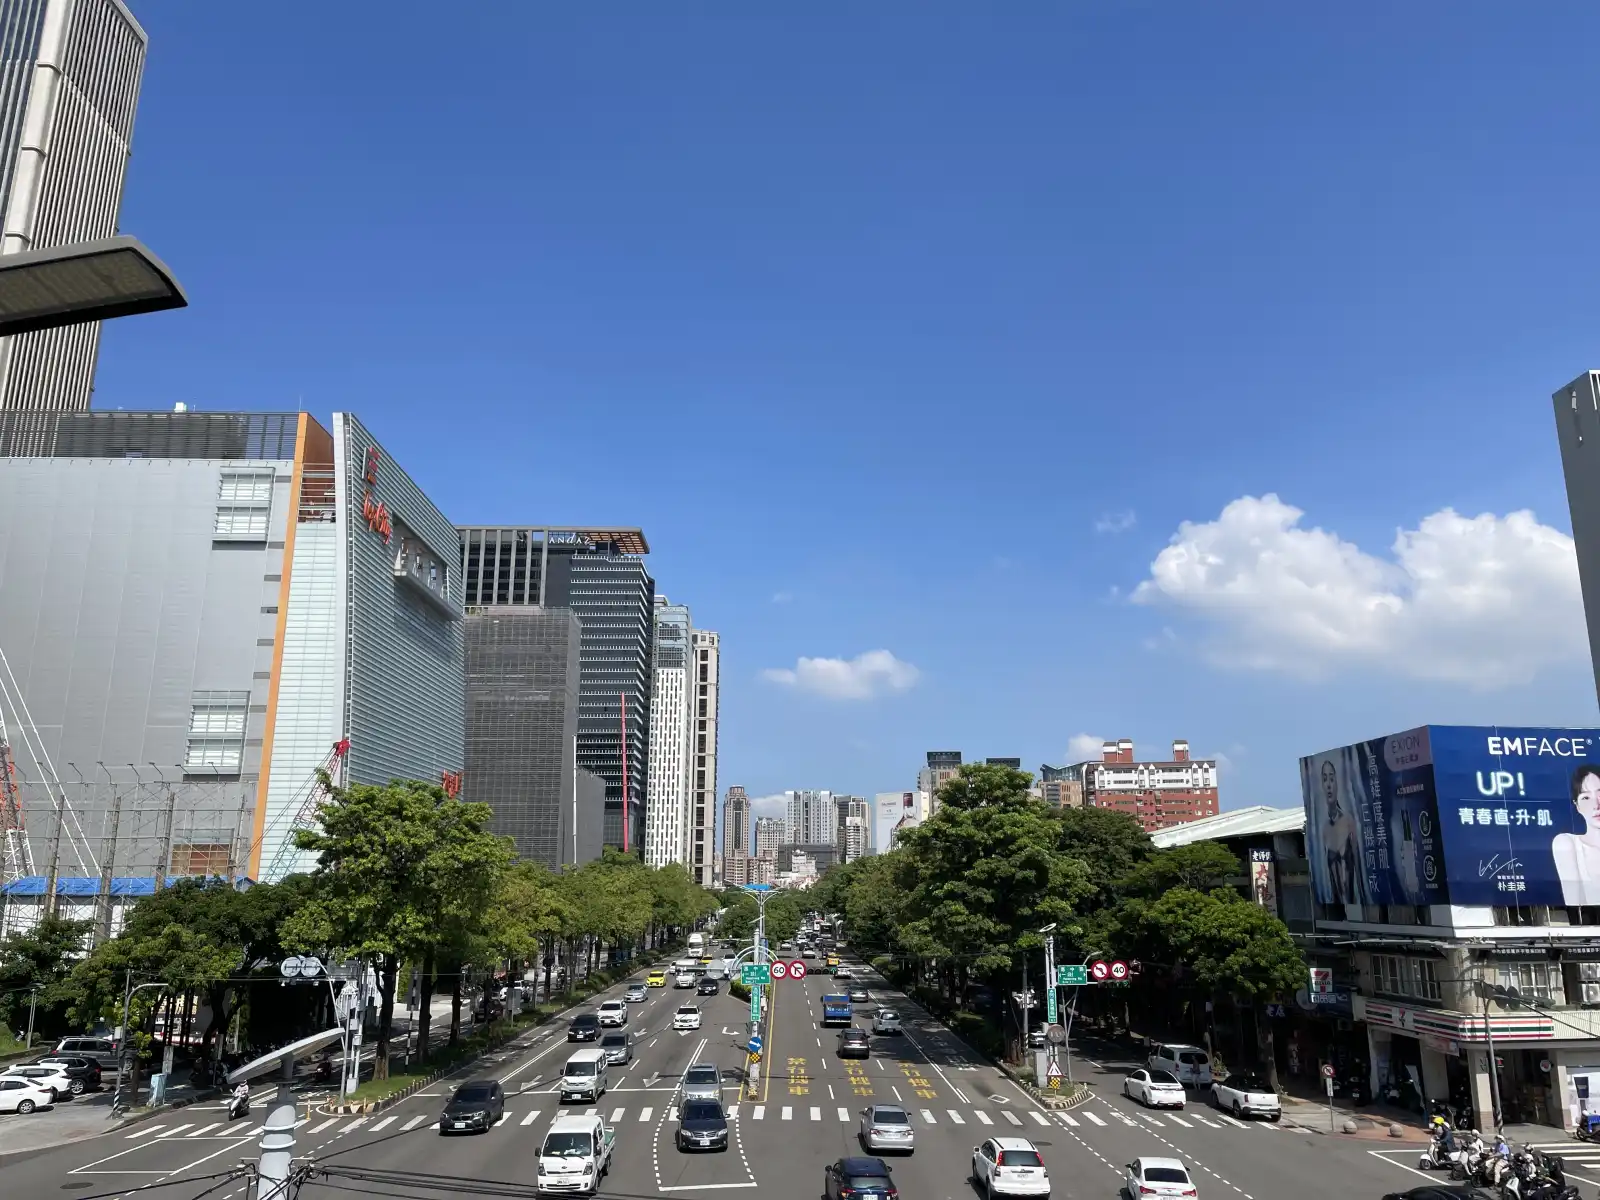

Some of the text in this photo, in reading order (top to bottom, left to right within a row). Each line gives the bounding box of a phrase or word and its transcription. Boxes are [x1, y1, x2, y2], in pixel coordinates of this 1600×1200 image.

[1476, 770, 1526, 796] UP!
[1497, 881, 1526, 892] 朴圭瑛
[773, 966, 785, 974] 60
[1113, 966, 1125, 974] 40
